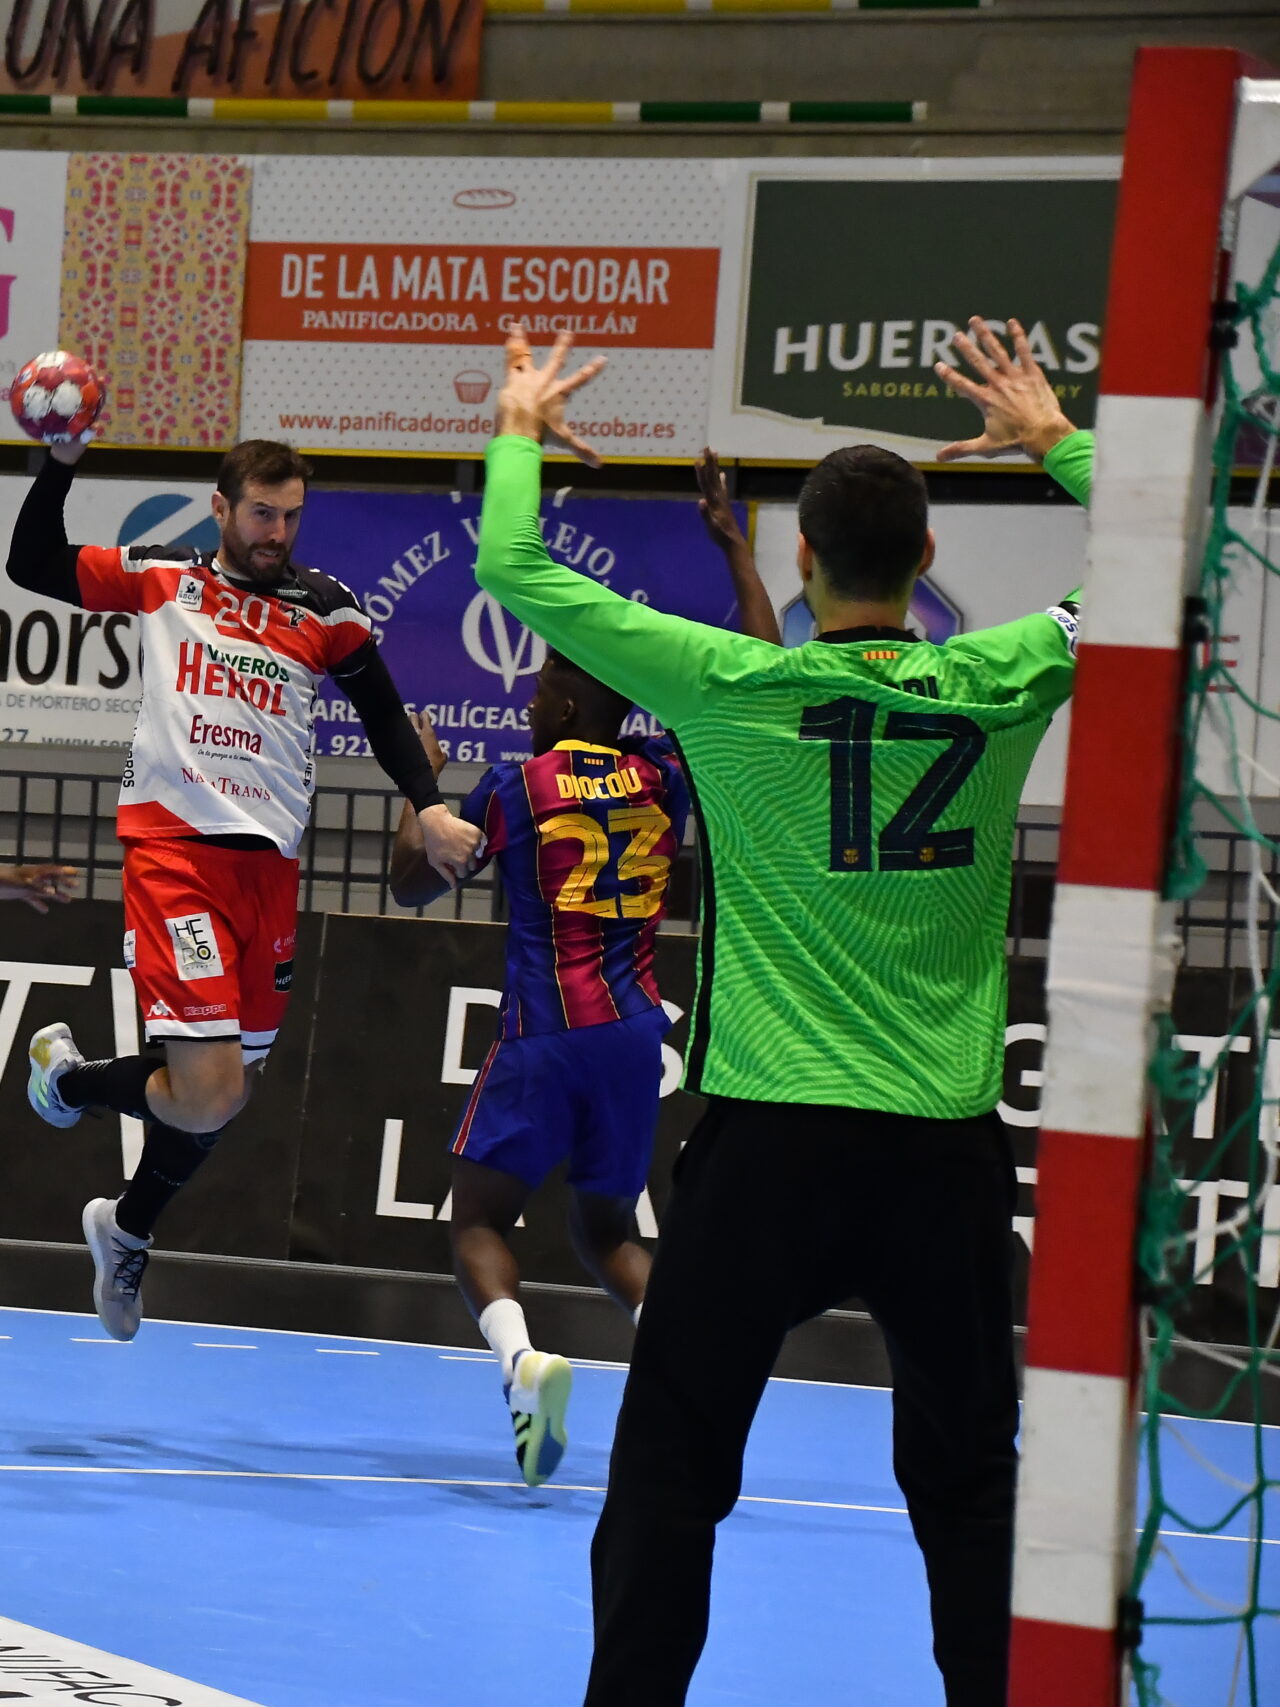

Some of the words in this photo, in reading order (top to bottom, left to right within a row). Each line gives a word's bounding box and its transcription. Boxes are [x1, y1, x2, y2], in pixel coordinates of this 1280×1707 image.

[281, 253, 326, 299] DE
[338, 254, 380, 300] LA
[392, 255, 491, 301] MATA
[501, 257, 671, 305] ESCOBAR
[301, 309, 478, 332] PANIFICADORA
[498, 311, 638, 335] GARCILLÁN
[843, 381, 939, 399] SABOREA
[215, 591, 270, 635] 20
[207, 643, 290, 682] VIVEROS
[6, 693, 25, 709] DE
[29, 695, 101, 712] MORTERO
[190, 714, 262, 755] Eresma
[456, 740, 488, 763] 61
[556, 767, 642, 800] DIOCOU
[799, 696, 987, 873] 12
[539, 804, 671, 919] 23
[184, 1003, 227, 1016] Kappa
